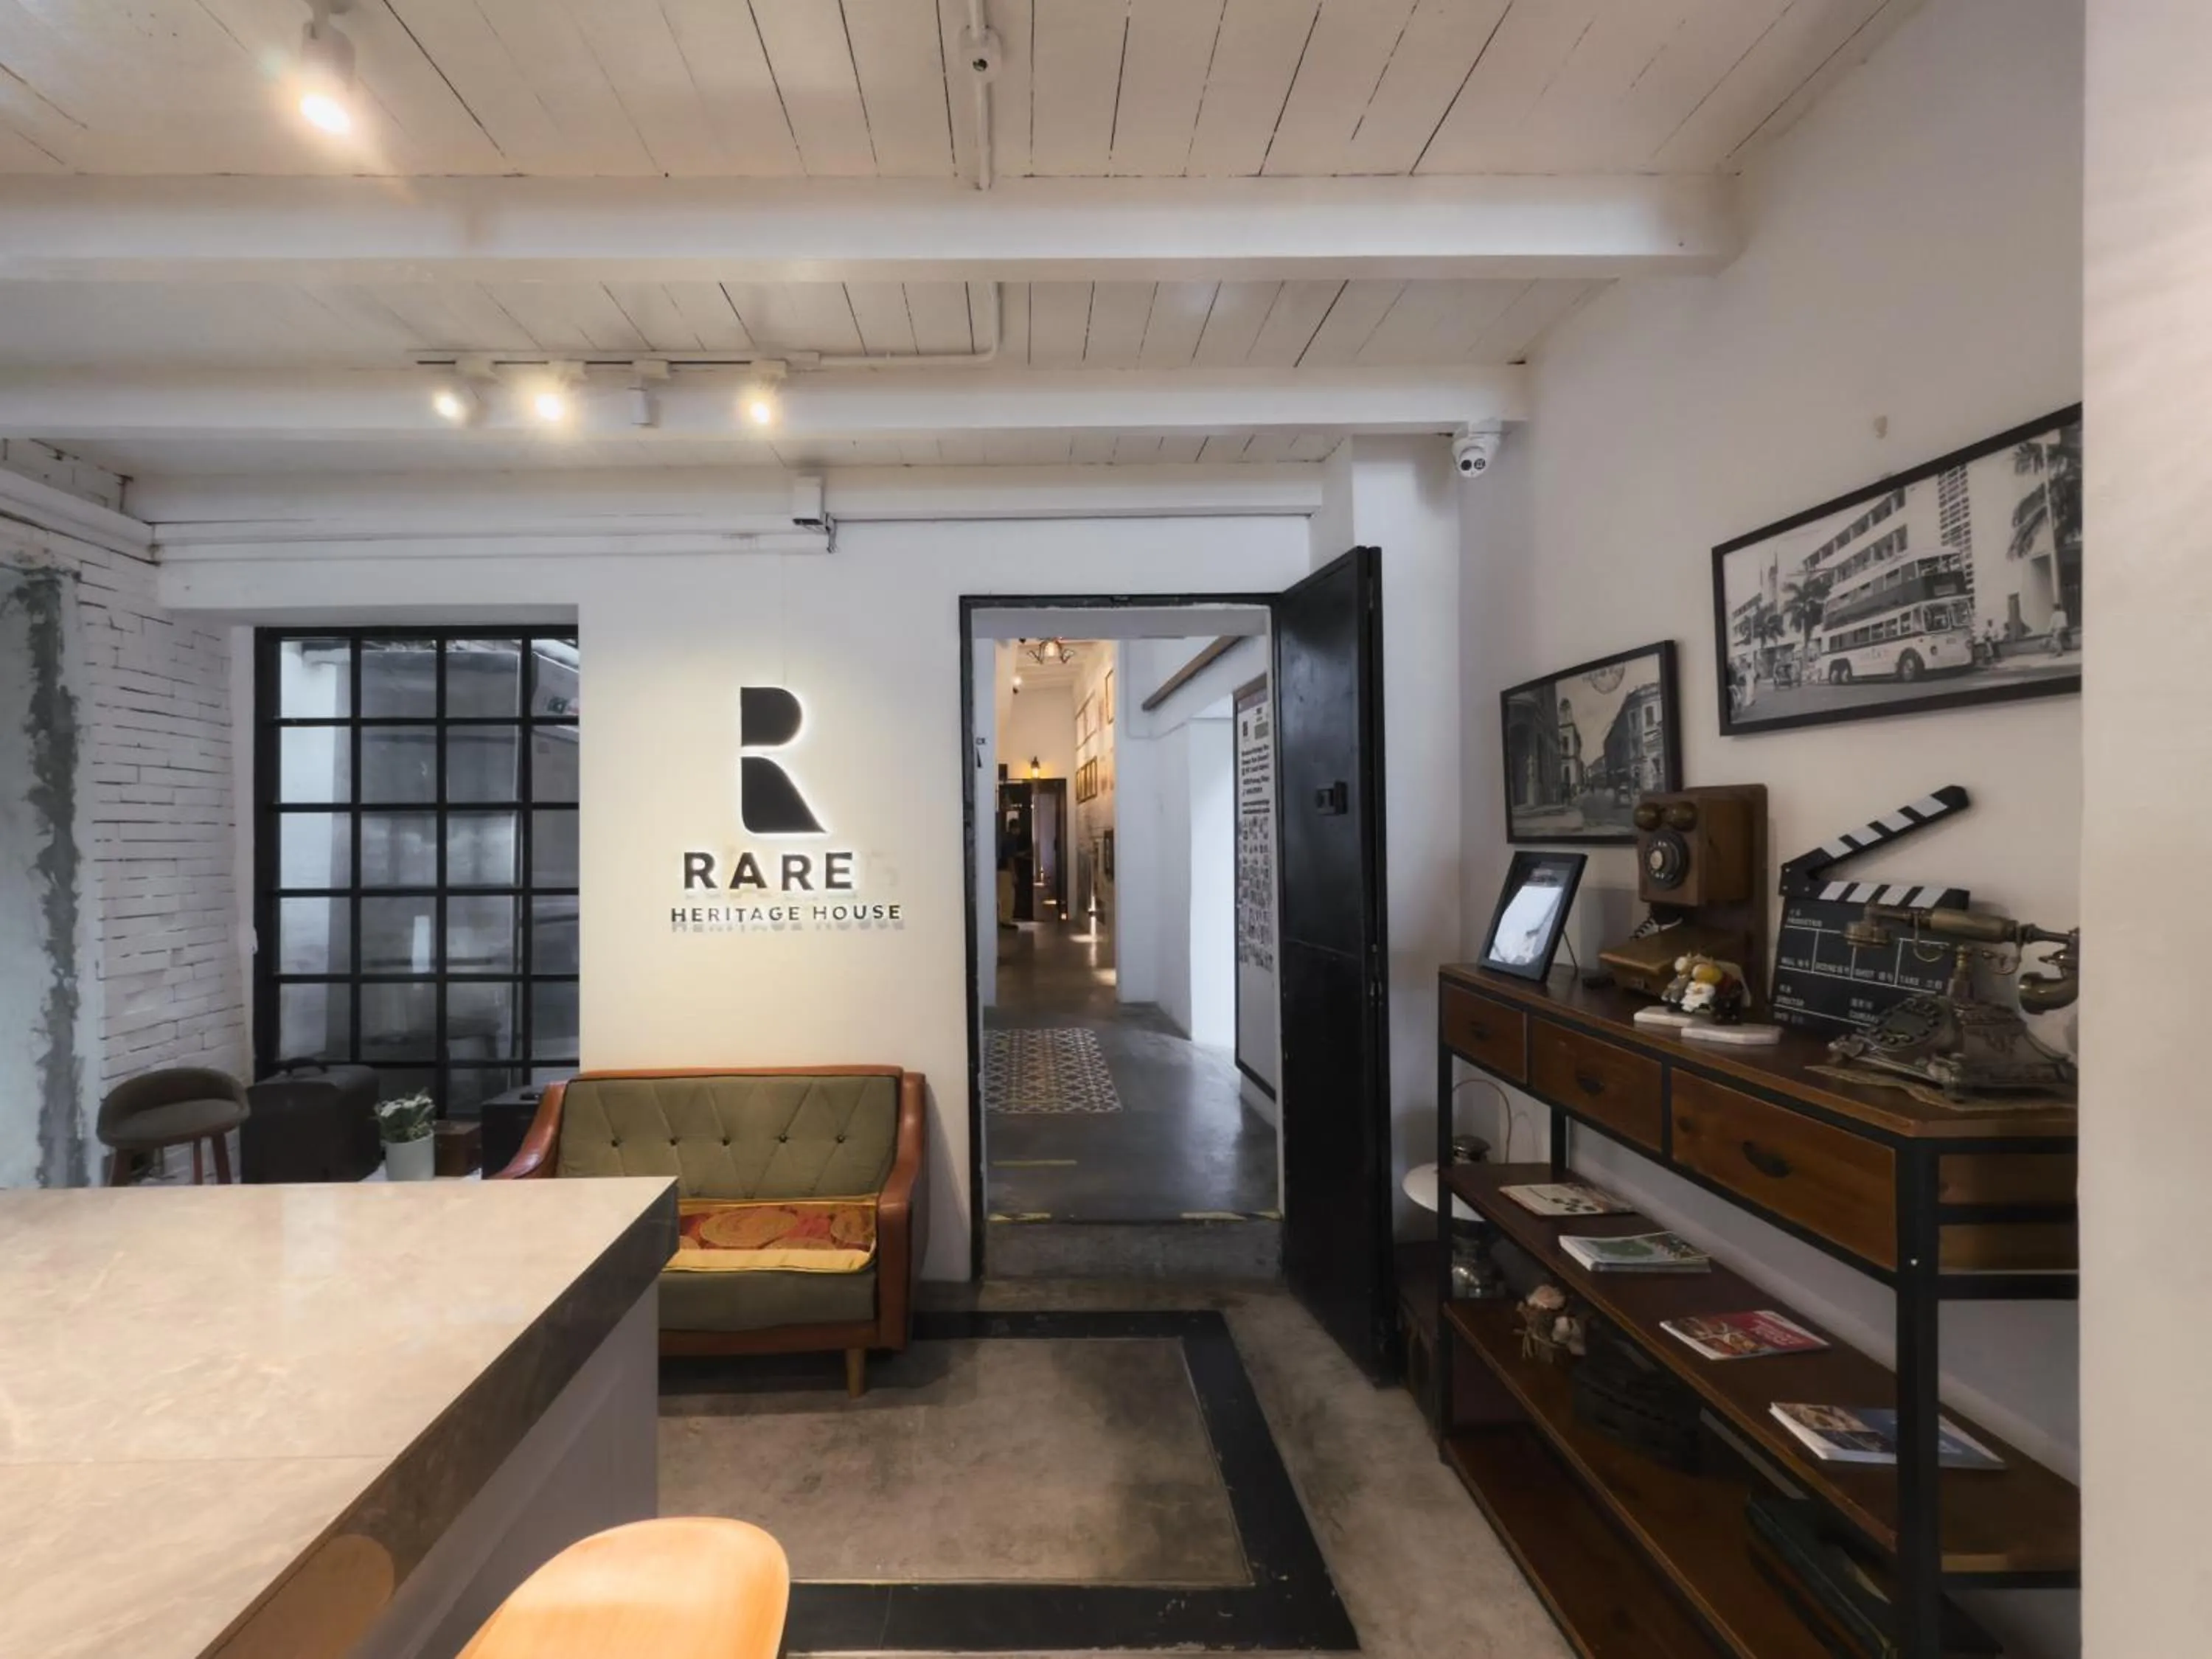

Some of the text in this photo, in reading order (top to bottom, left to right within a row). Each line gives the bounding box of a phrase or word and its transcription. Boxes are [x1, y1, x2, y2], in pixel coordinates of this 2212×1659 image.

[684, 852, 853, 891] RARE
[671, 905, 901, 922] HERITAGE HOUSE
